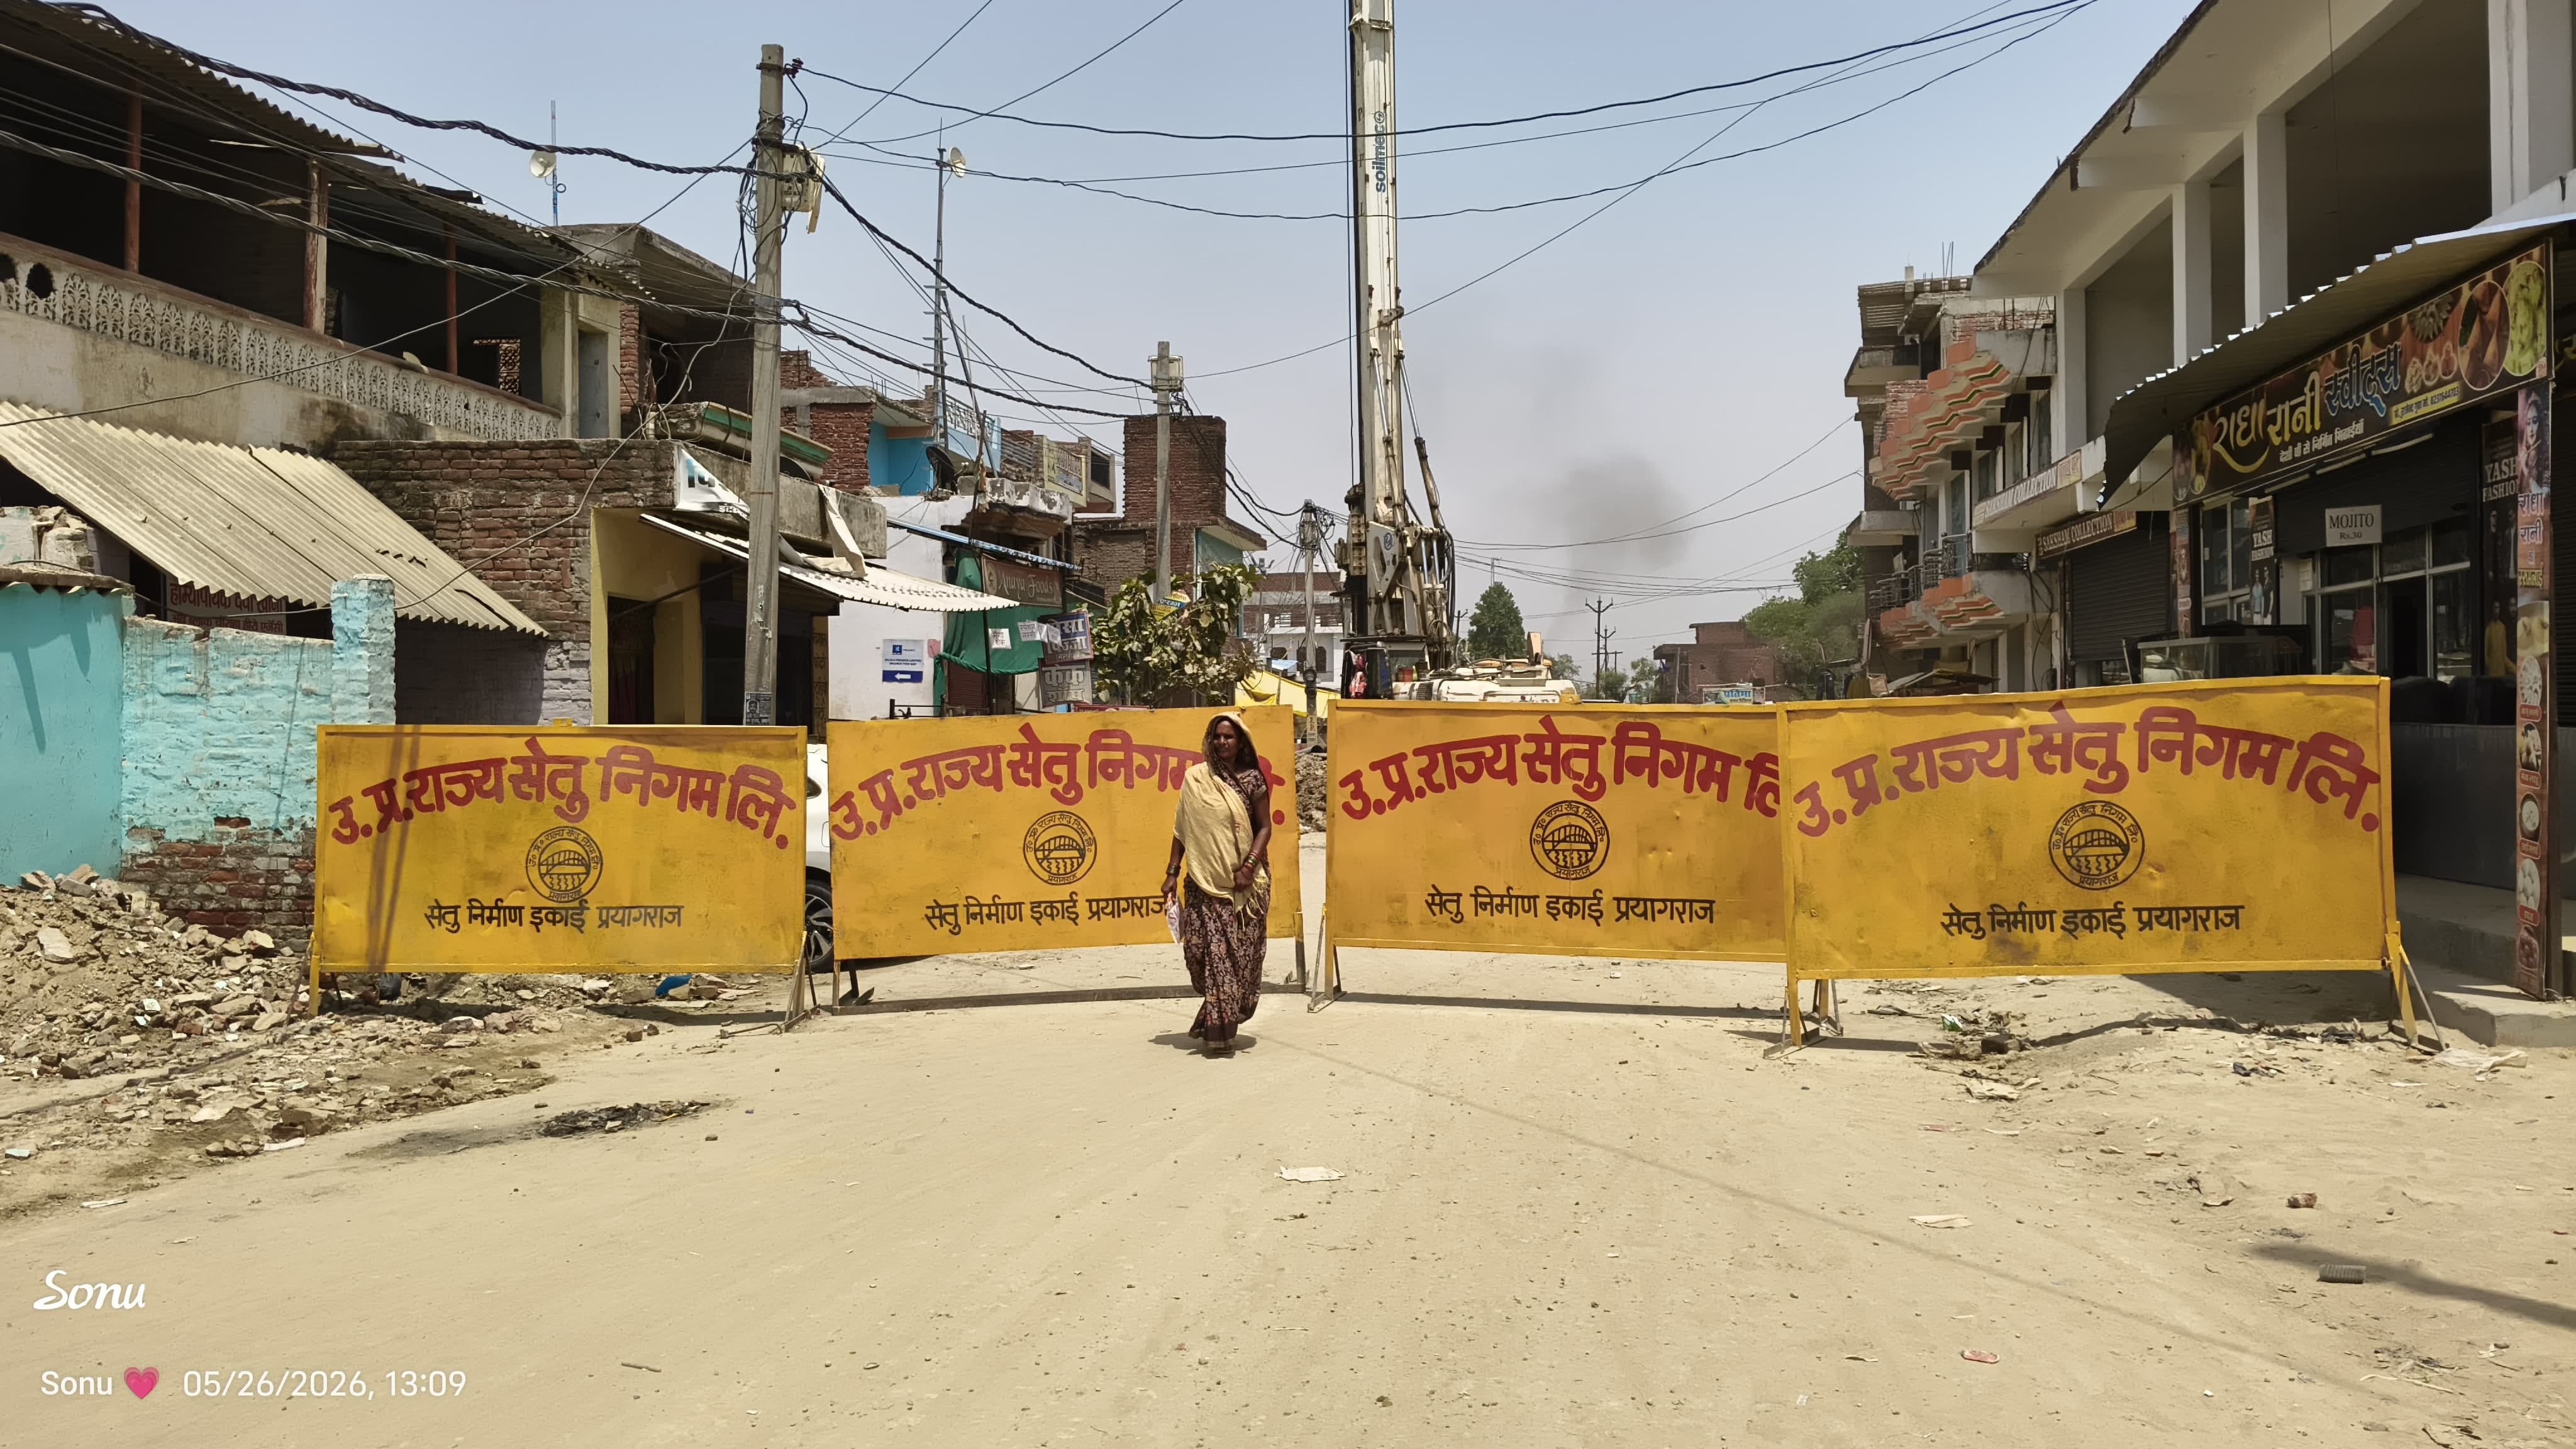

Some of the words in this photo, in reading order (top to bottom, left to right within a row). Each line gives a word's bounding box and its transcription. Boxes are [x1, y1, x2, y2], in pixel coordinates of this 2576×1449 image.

[1372, 124, 1386, 193] soilmec
[2213, 399, 2270, 473] राधा
[2267, 371, 2321, 446] रानी
[2324, 343, 2401, 417] स्वीट्स
[2303, 440, 2311, 455] से
[2013, 467, 2057, 506] COLLECTION
[2485, 456, 2518, 483] YASH
[2042, 528, 2071, 552] SAKSHAM
[2071, 513, 2113, 543] COLLECTION
[2253, 530, 2273, 548] YASH
[2329, 513, 2374, 529] MOJITO
[2340, 531, 2363, 540] Rs.30
[2519, 518, 2544, 545] रानी
[998, 572, 1026, 600] Anaya
[1027, 574, 1053, 598] Foods
[1042, 664, 1085, 687] केक
[1007, 722, 1082, 806] सेतु
[1521, 714, 1606, 801] सेतु
[1611, 721, 1741, 803] निगम
[2028, 700, 2126, 794] सेतु
[2133, 706, 2294, 786] निगम
[2287, 731, 2381, 833] लि.
[508, 736, 589, 823] सेतु
[596, 745, 726, 819] निगम
[726, 763, 797, 850] लि.
[2100, 803, 2128, 824] निगम
[2078, 872, 2119, 886] प्रयागराज
[424, 899, 460, 934] सेतु
[468, 899, 525, 930] निर्माण
[530, 900, 588, 933] इकाई
[597, 905, 684, 929] प्रयागराज
[924, 898, 962, 935] सेतु
[965, 894, 1025, 924] निर्माण
[1030, 891, 1080, 926] इकाई
[1425, 883, 1465, 923] सेतु
[1470, 885, 1540, 918] निर्माण
[1546, 888, 1603, 926] इकाई
[1613, 896, 1716, 924] प्रयागराज
[1940, 902, 1986, 941] सेतु
[1988, 902, 2055, 933] निर्माण
[2061, 901, 2127, 941] इकाई
[2133, 904, 2245, 932] प्रयागराज
